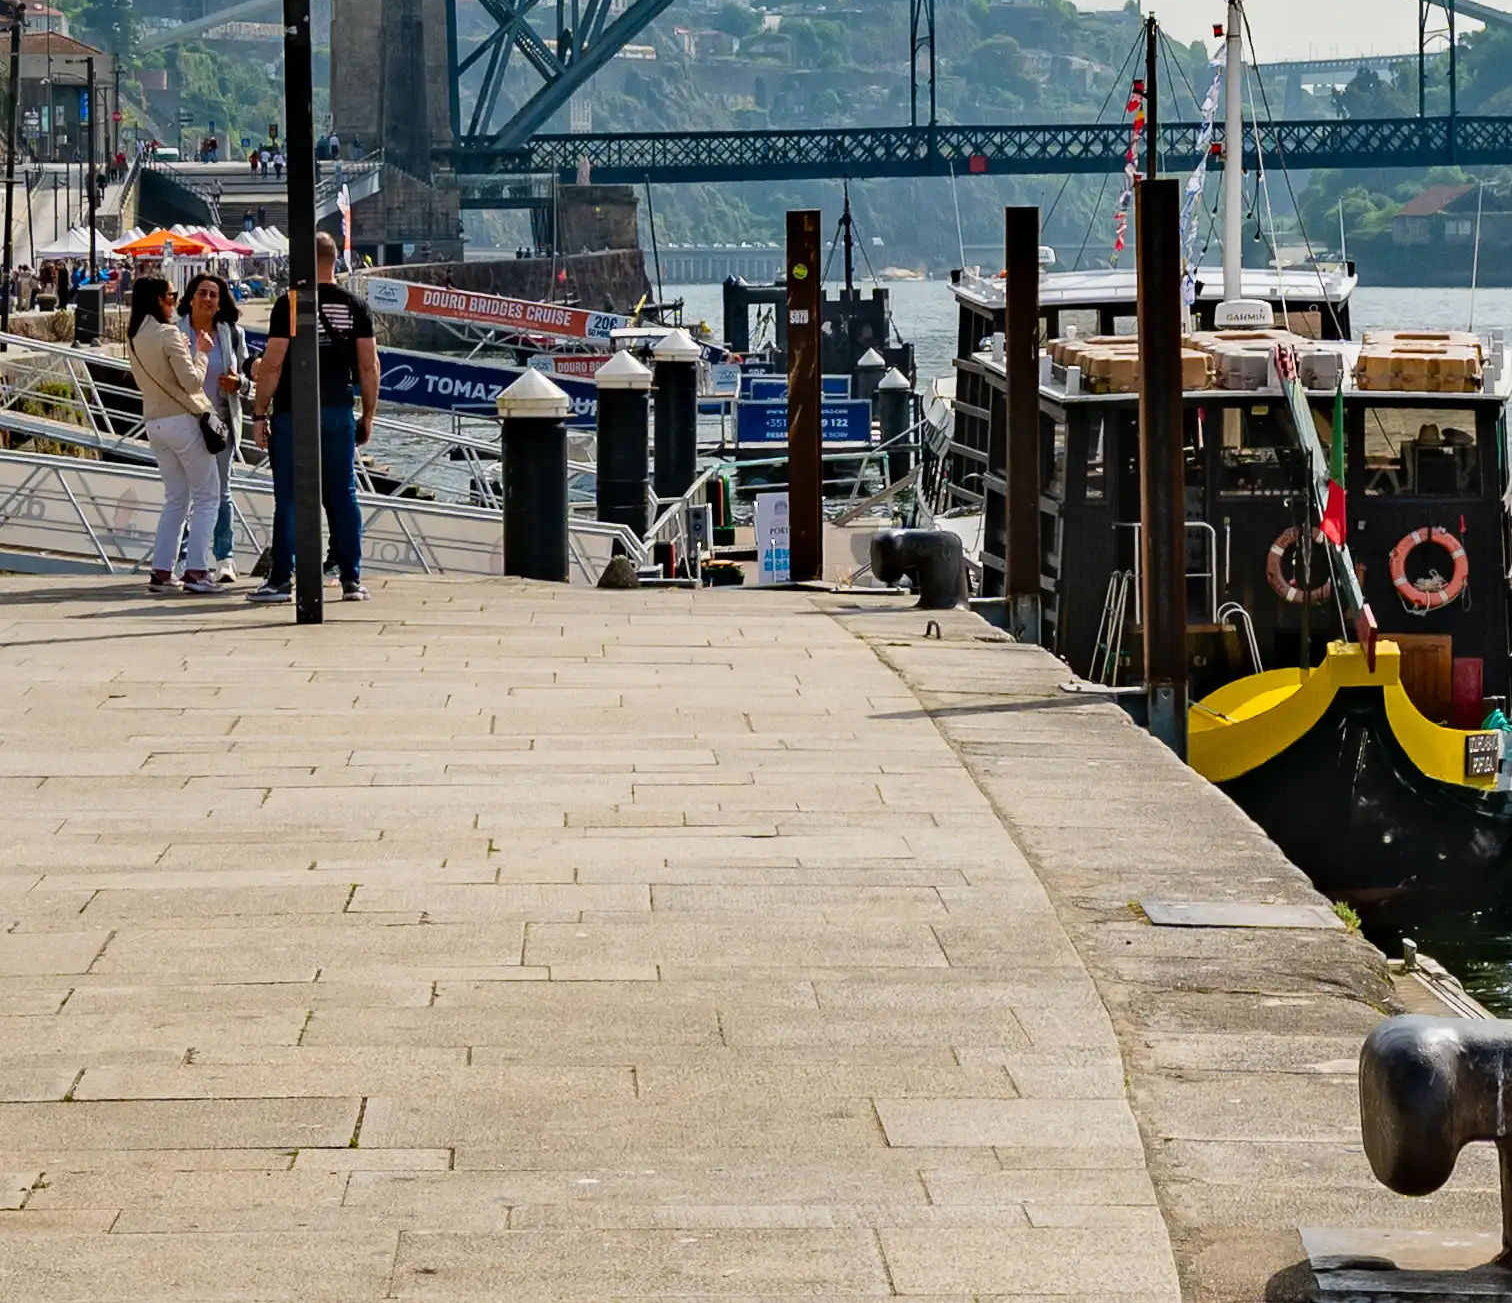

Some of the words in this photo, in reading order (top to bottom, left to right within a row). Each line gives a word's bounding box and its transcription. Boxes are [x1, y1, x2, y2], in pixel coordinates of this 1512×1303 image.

[423, 290, 466, 310] DOURO
[469, 297, 522, 318] BRIDGES
[526, 305, 572, 327] CRUISE
[557, 361, 587, 373] DOURO
[425, 374, 503, 401] TOMAZ
[831, 418, 848, 427] 122
